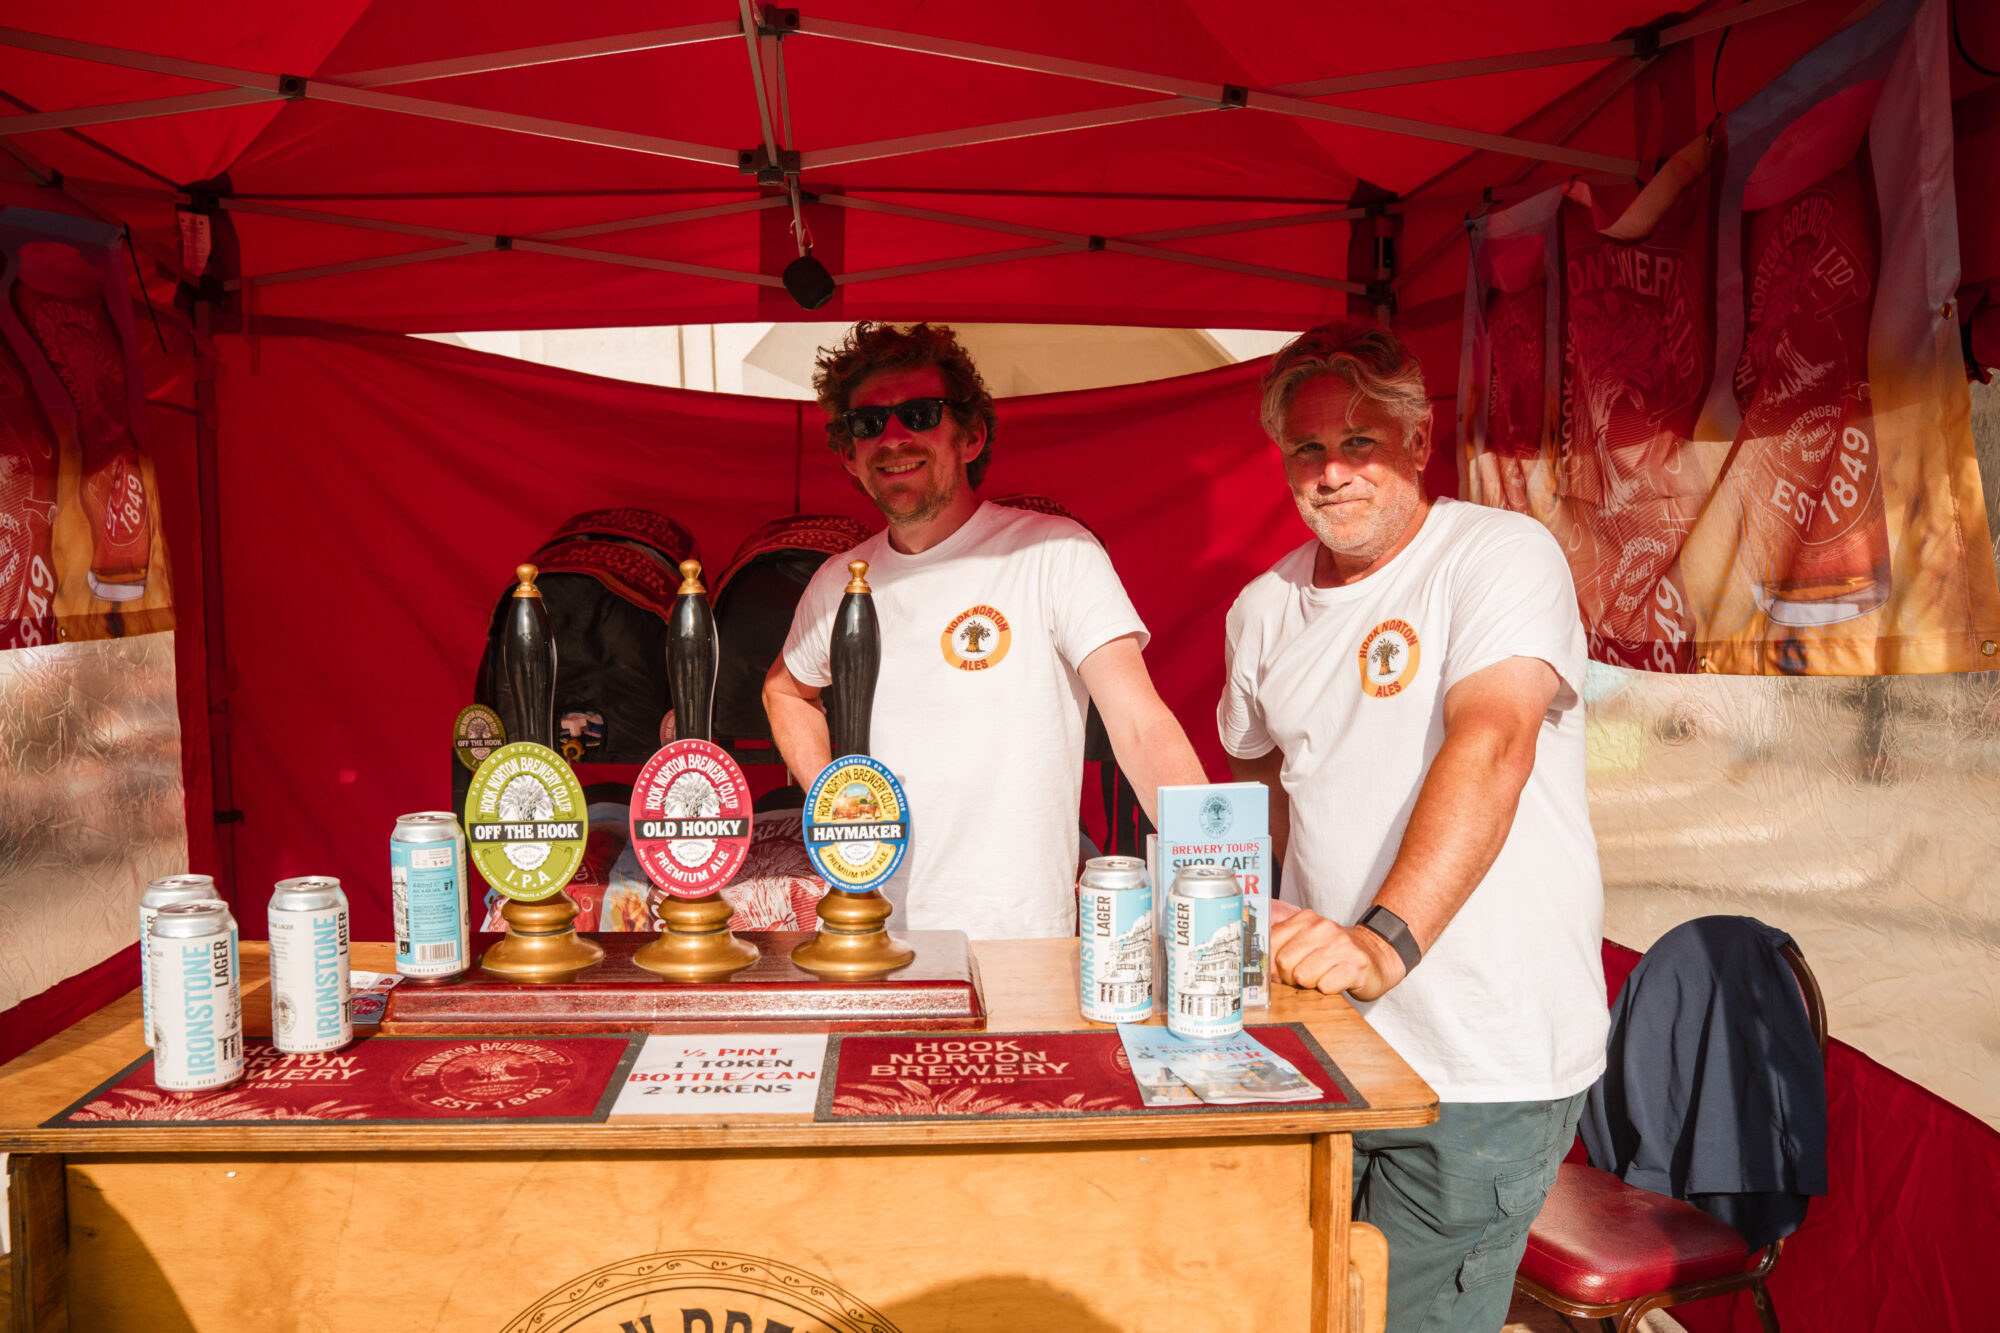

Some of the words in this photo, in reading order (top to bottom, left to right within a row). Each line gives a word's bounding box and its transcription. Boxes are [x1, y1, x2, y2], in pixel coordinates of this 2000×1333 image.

[1750, 231, 1783, 323] NORTON
[1780, 404, 1842, 453] INDEPENDENT
[1800, 420, 1834, 449] FAMILY
[1821, 427, 1870, 525] 1849
[119, 474, 143, 534] 1849
[944, 610, 971, 635] HOOK
[972, 605, 1009, 633] NORTON
[1359, 626, 1380, 659] HOOK
[1382, 619, 1418, 647] NORTON
[959, 659, 989, 671] ALES
[1375, 681, 1402, 698] ALES
[470, 739, 484, 747] THE
[487, 758, 521, 790] NORTON
[521, 757, 560, 786] BREWERY
[638, 756, 663, 793] FRUITY
[684, 743, 711, 753] FULL
[719, 754, 745, 792] BODIED
[653, 755, 687, 786] NORTON
[688, 753, 729, 784] BREWERY
[838, 758, 872, 767] DANCING
[824, 769, 852, 797] NORTON
[853, 768, 889, 794] BREWERY
[480, 787, 499, 814] HOOK
[645, 785, 665, 811] HOOK
[817, 796, 833, 817] HOOK
[474, 825, 502, 840] OFF
[504, 824, 534, 839] THE
[537, 823, 579, 839] HOOK
[642, 822, 677, 837] OLD
[680, 820, 742, 836] HOOKY
[813, 824, 902, 841] HAYMAKER
[1172, 844, 1224, 856] BREWERY
[1227, 842, 1260, 853] TOURS
[1222, 852, 1260, 870] CAFÉ
[654, 851, 709, 883] PREMIUM
[709, 850, 730, 874] ALE
[826, 853, 858, 879] PREMIUM
[860, 864, 877, 878] PALE
[876, 850, 889, 867] ALE
[1096, 895, 1111, 938] LAGER
[1177, 902, 1190, 946] LAGER
[338, 911, 348, 956] LAGER
[213, 939, 229, 988] LAGER
[1081, 893, 1094, 1009] IRONSTONE
[313, 914, 341, 1039] IRONSTONE
[182, 943, 217, 1076] IRONSTONE
[718, 1048, 783, 1057] PINT
[890, 1051, 1047, 1065] NORTON
[915, 1040, 1022, 1053] HOOK
[245, 1068, 367, 1080] WERY
[628, 1071, 816, 1082] BOTTLE/CAN
[699, 1059, 794, 1069] TOKEN
[870, 1062, 1070, 1077] BREWERY
[430, 1096, 483, 1111] EST
[493, 1087, 552, 1109] 1849
[642, 1086, 668, 1095] 2
[674, 1084, 793, 1094] TOKENS
